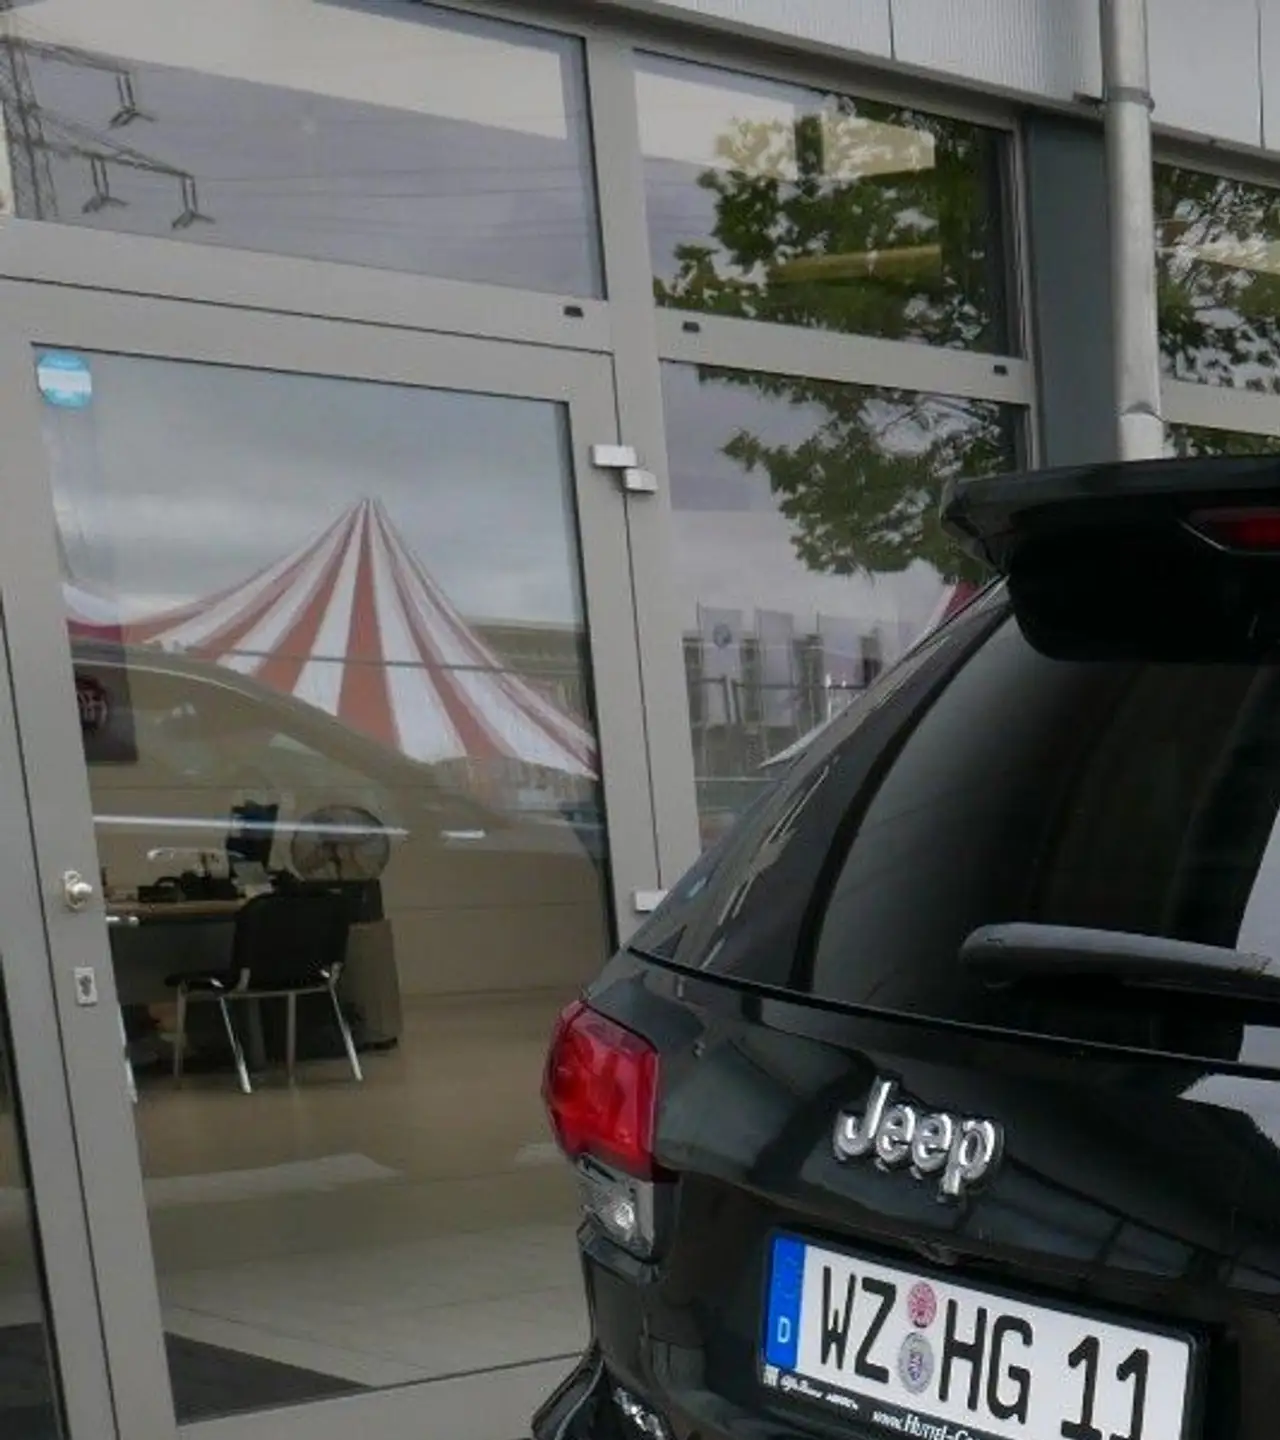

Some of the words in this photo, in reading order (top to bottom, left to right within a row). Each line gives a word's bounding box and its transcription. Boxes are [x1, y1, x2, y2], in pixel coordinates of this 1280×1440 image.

[835, 1076, 1001, 1197] Jeep
[776, 1317, 791, 1343] D
[821, 1266, 896, 1384] WZ
[939, 1298, 1033, 1424] HG
